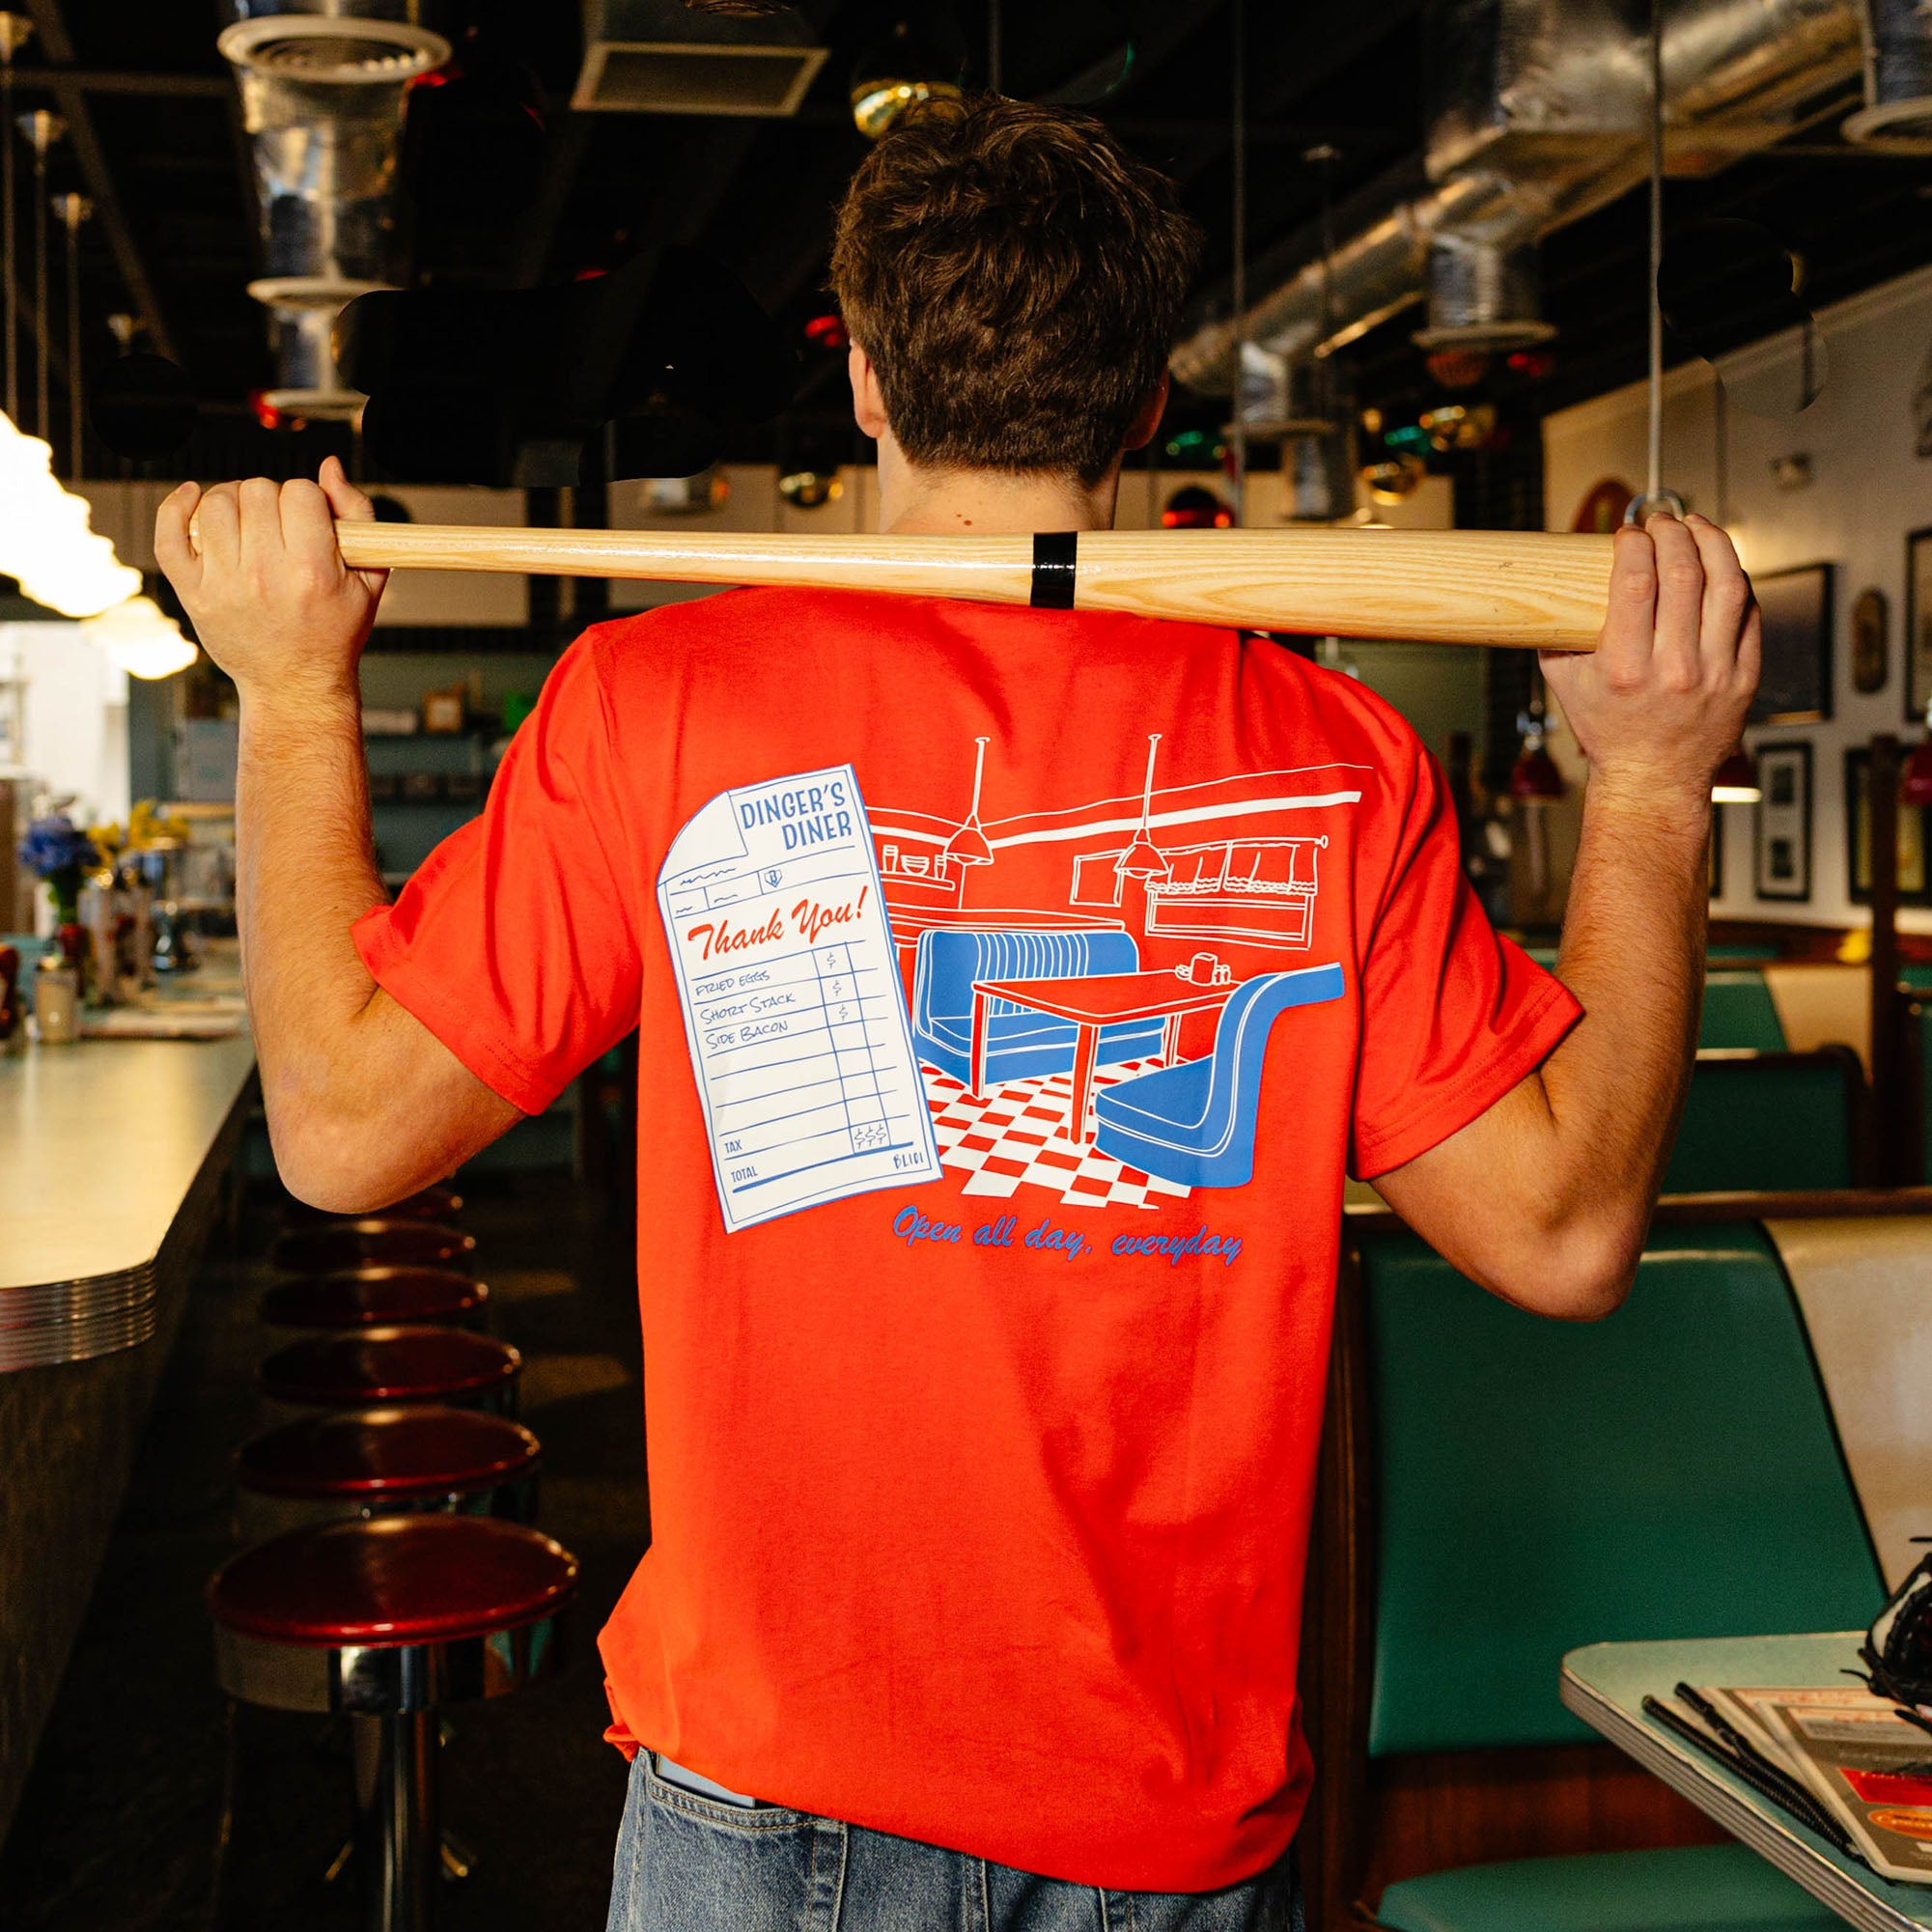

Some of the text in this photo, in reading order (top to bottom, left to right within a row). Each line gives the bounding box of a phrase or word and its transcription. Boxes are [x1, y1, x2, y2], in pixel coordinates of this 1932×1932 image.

[740, 781, 846, 829] DINGER'S
[781, 810, 853, 851] DINER
[687, 885, 868, 961] Thank You!
[695, 977, 735, 996] FRIED
[739, 970, 770, 986] EGGS
[749, 993, 796, 1014] STACK
[740, 1021, 788, 1042] BACON
[724, 1139, 742, 1153] TAX
[730, 1165, 758, 1183] TOTAL
[892, 1205, 962, 1246] Open
[973, 1215, 1016, 1246] all
[1111, 1225, 1243, 1267] everyday
